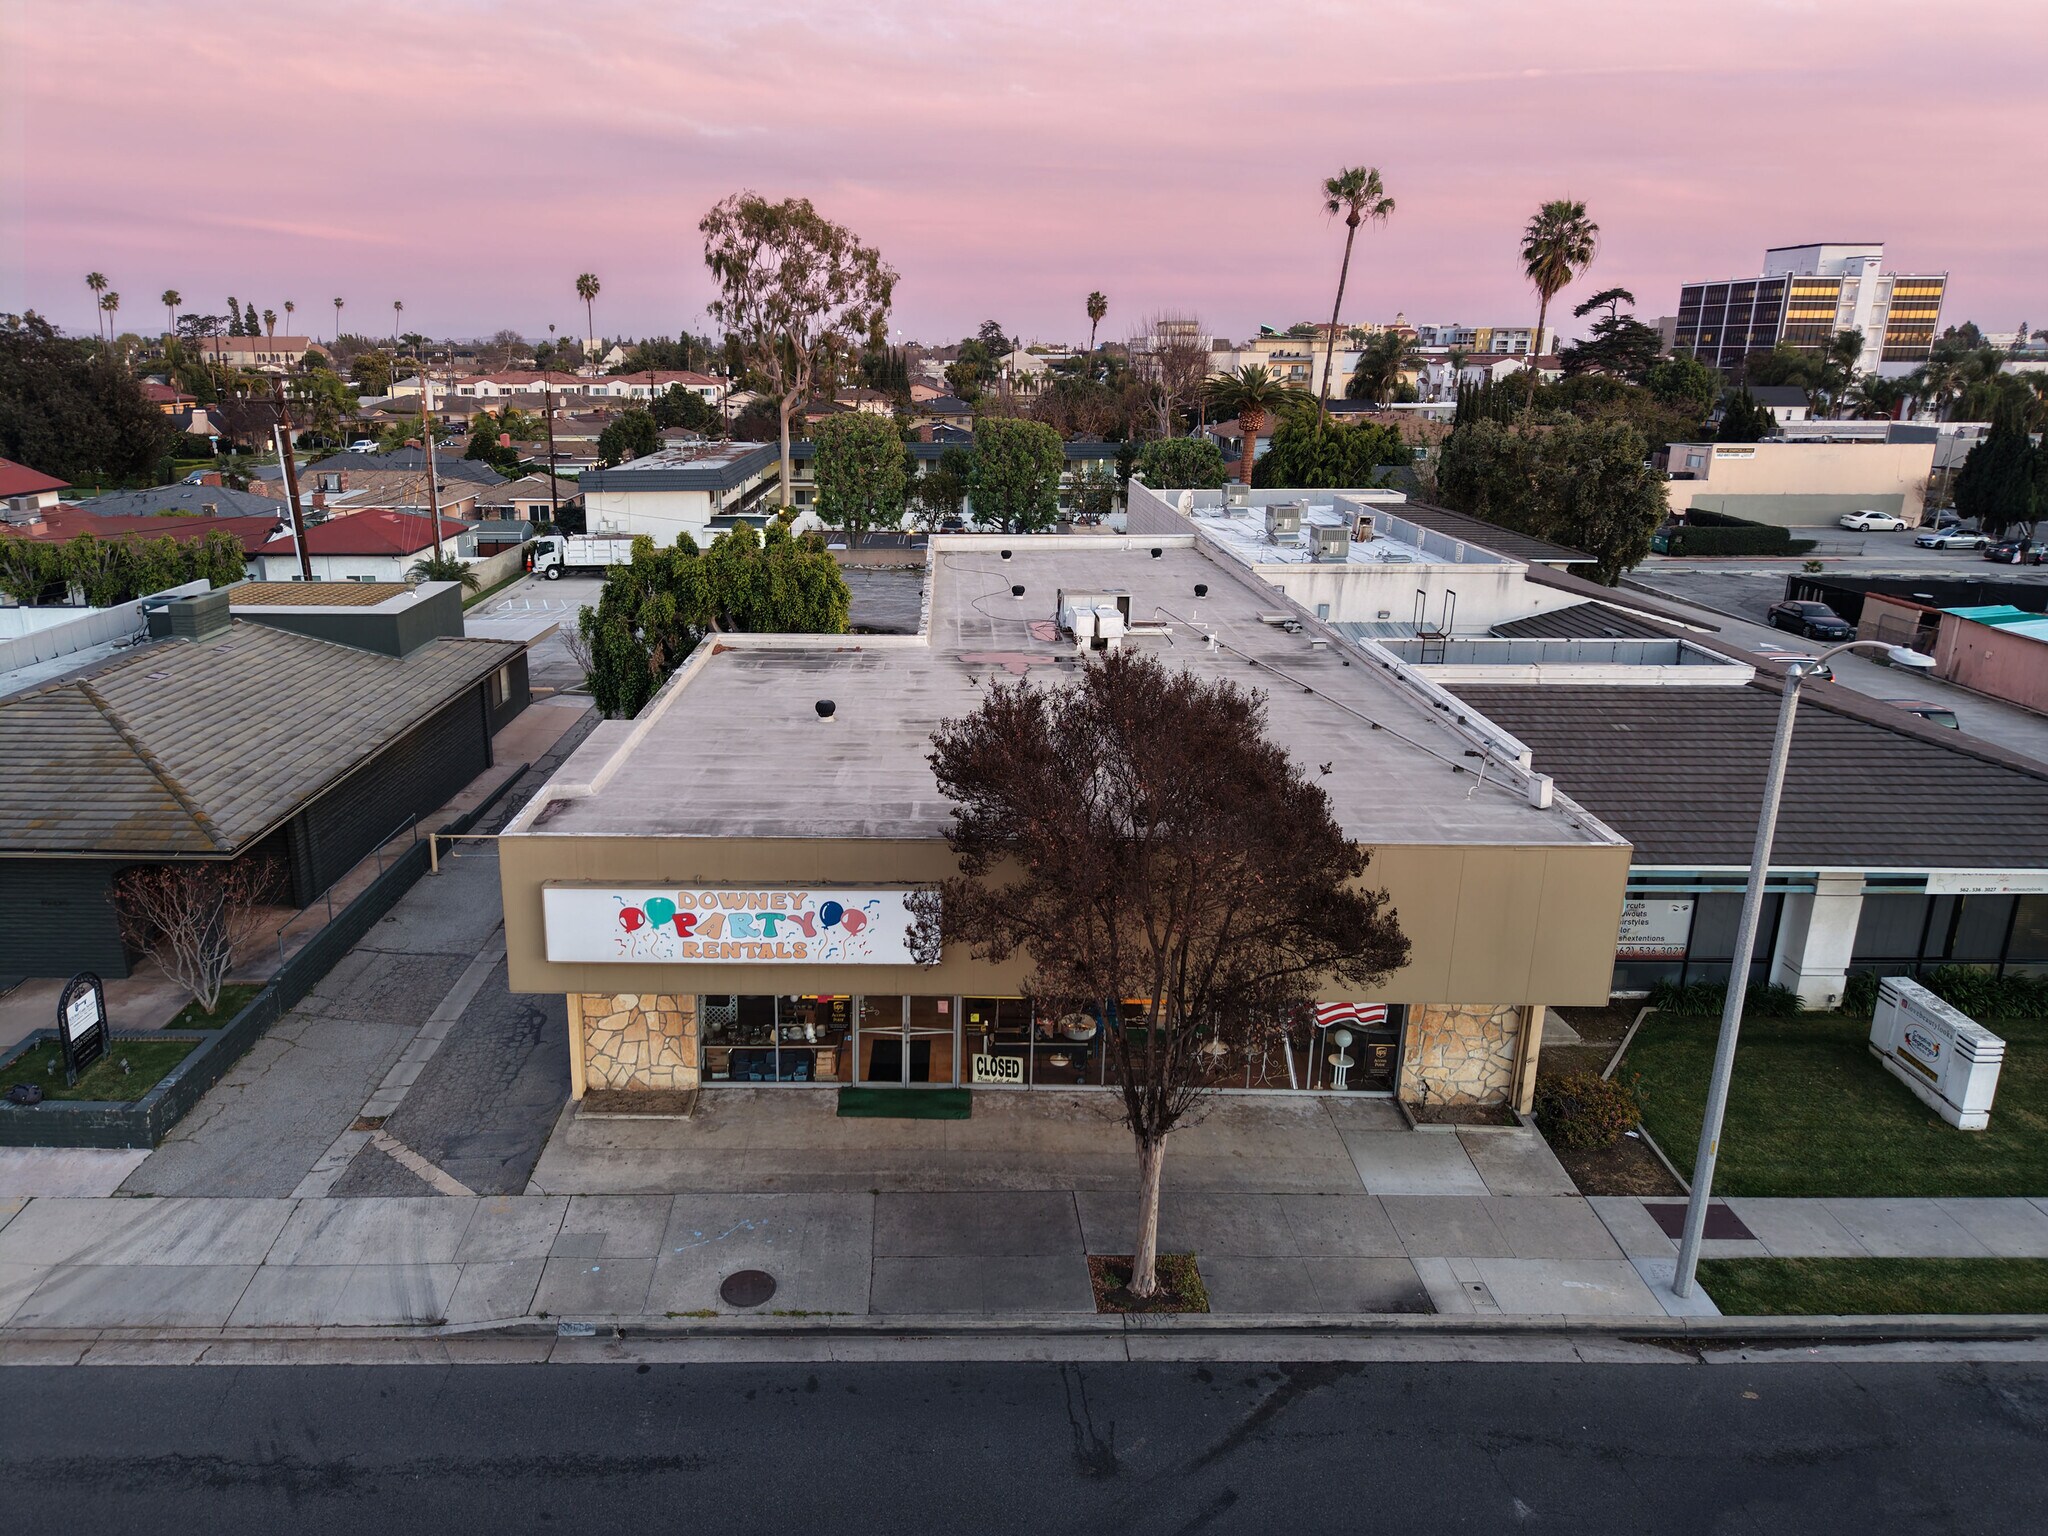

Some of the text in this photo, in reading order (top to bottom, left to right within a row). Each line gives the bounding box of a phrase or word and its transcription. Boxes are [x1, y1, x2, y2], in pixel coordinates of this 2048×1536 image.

[678, 892, 808, 910] DOWNEY
[672, 912, 817, 940] PARTY
[682, 941, 808, 959] RENTALS
[977, 1056, 1020, 1078] CLOSED
